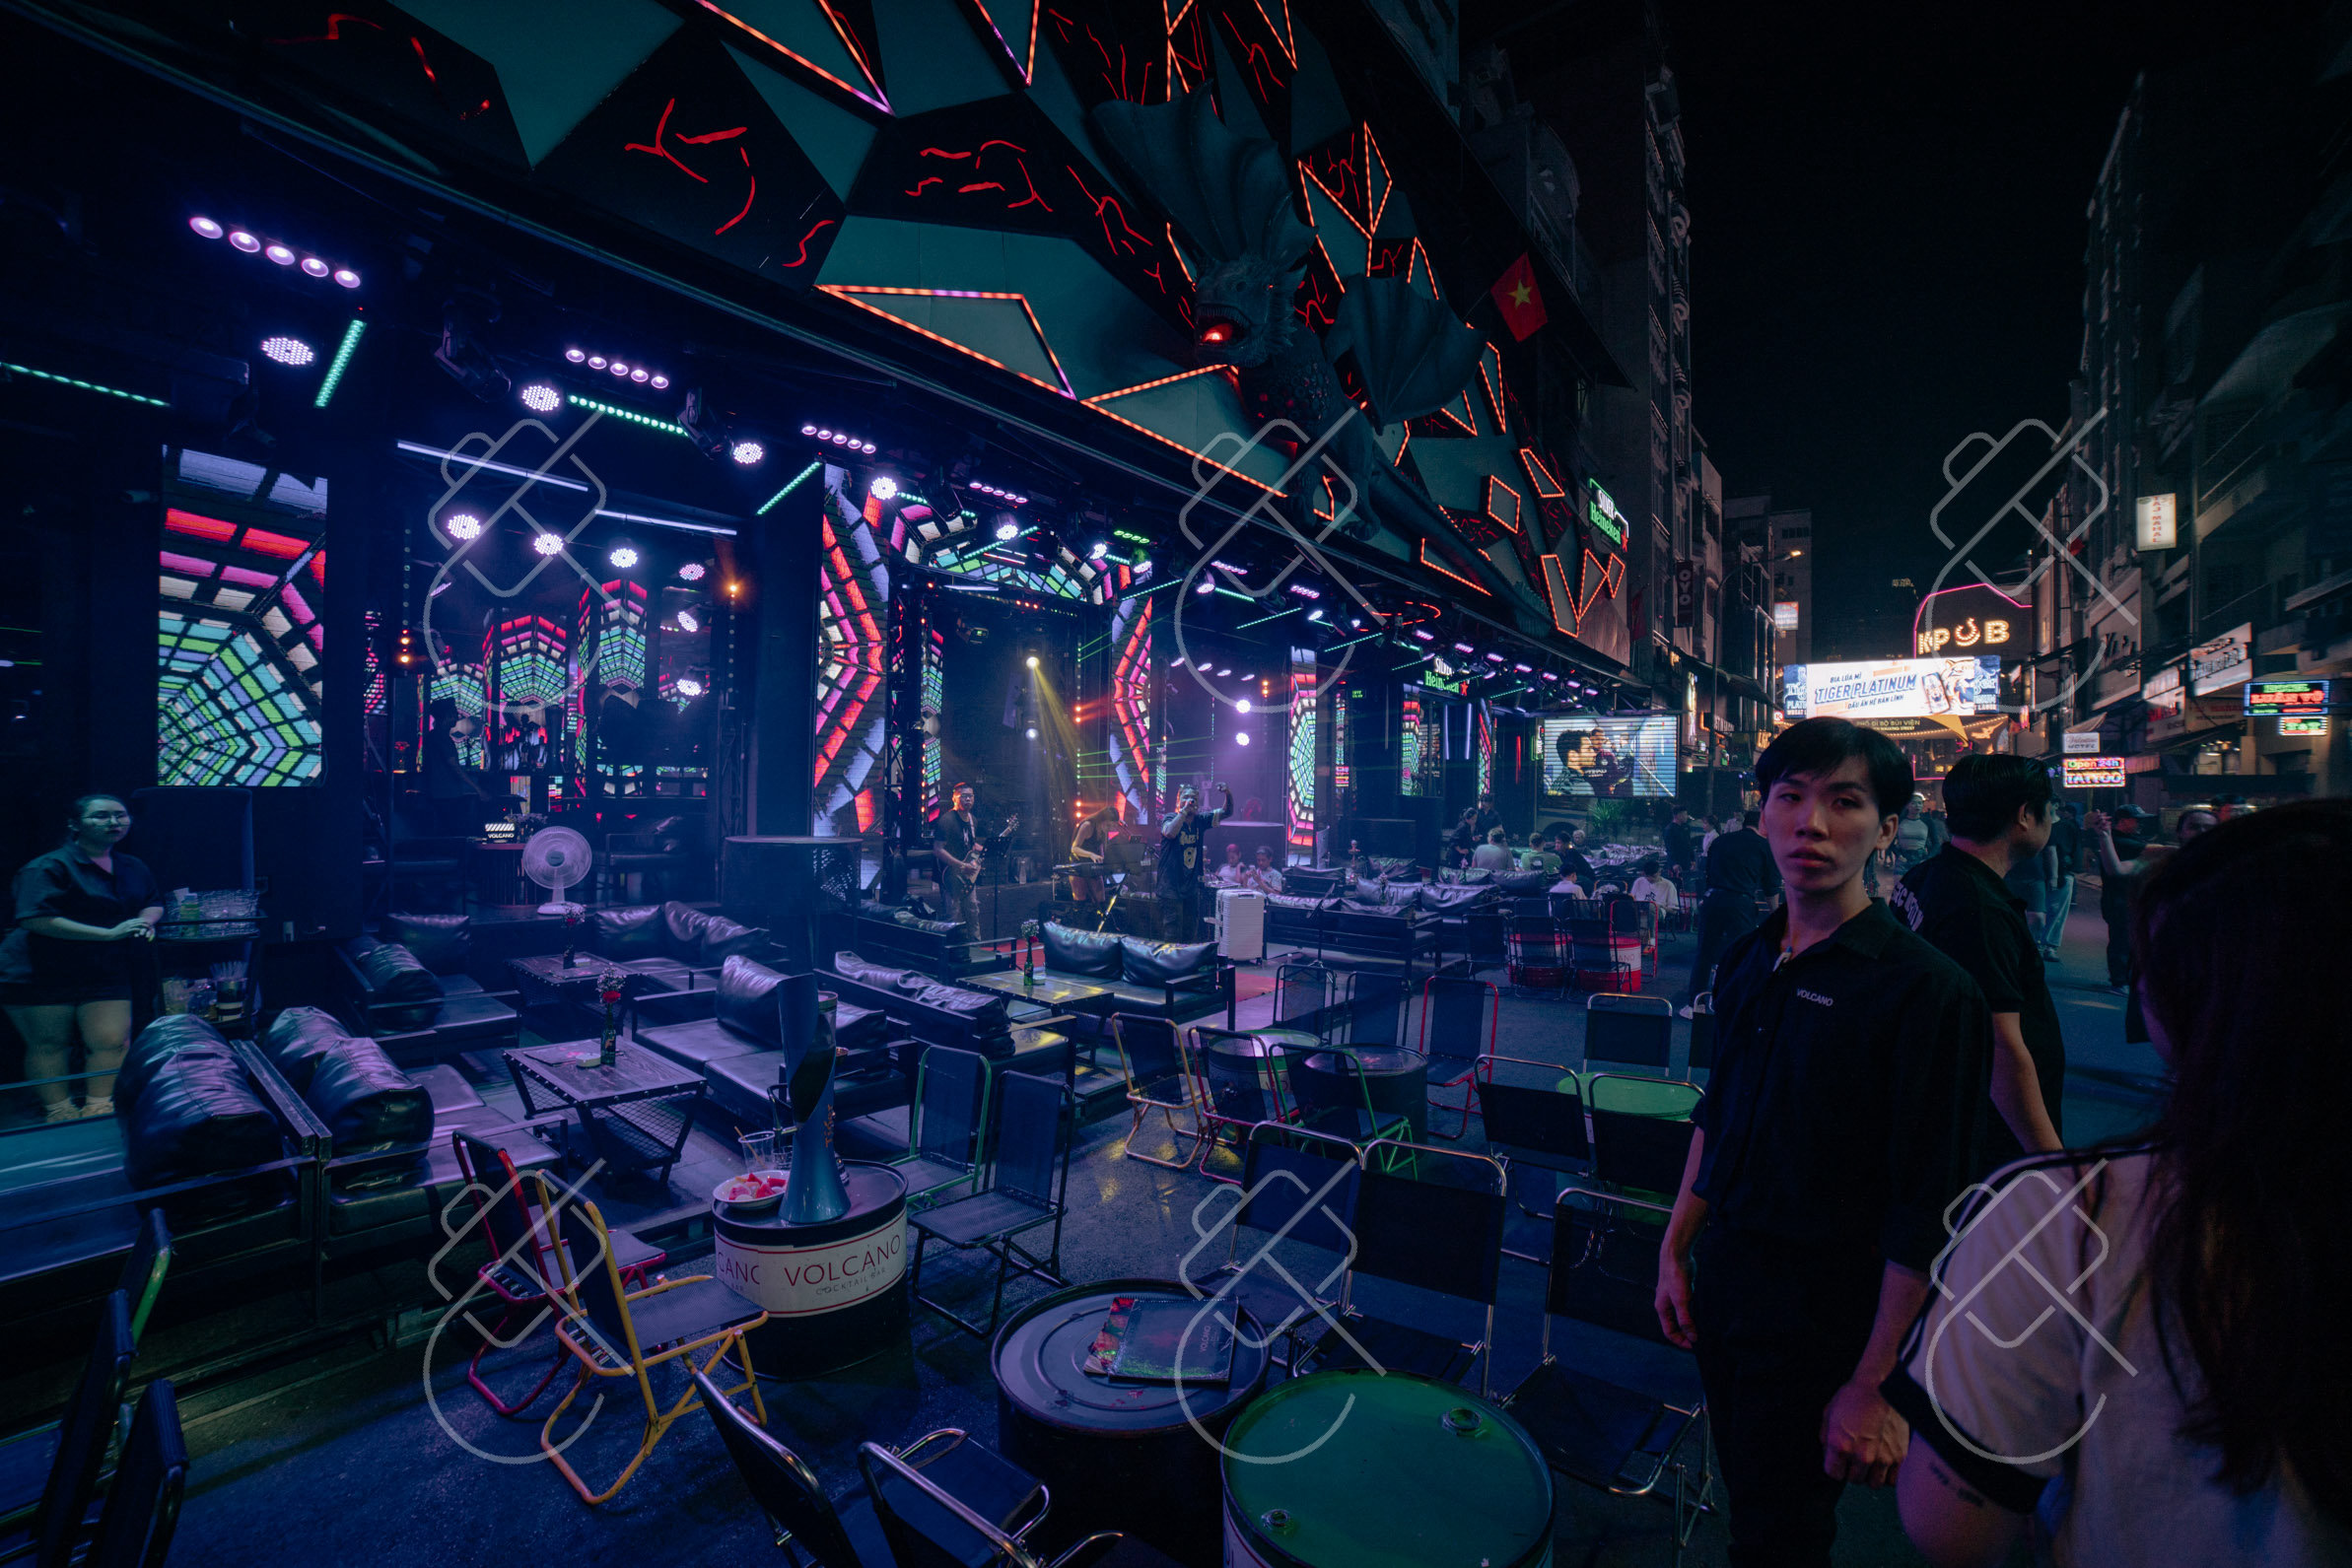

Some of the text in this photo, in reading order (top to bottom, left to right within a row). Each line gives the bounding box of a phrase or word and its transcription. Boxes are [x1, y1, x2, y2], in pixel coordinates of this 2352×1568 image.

[1590, 500, 1622, 545] Heineken
[1679, 569, 1692, 606] OYO
[1818, 674, 1917, 702] TIGER PLATINUM
[2066, 771, 2123, 784] TATTOO
[2067, 760, 2098, 769] Open
[1796, 989, 1833, 1006] VOLCANO
[784, 1234, 901, 1287] VOLCANO
[815, 1266, 886, 1296] COCKTAIL BAR
